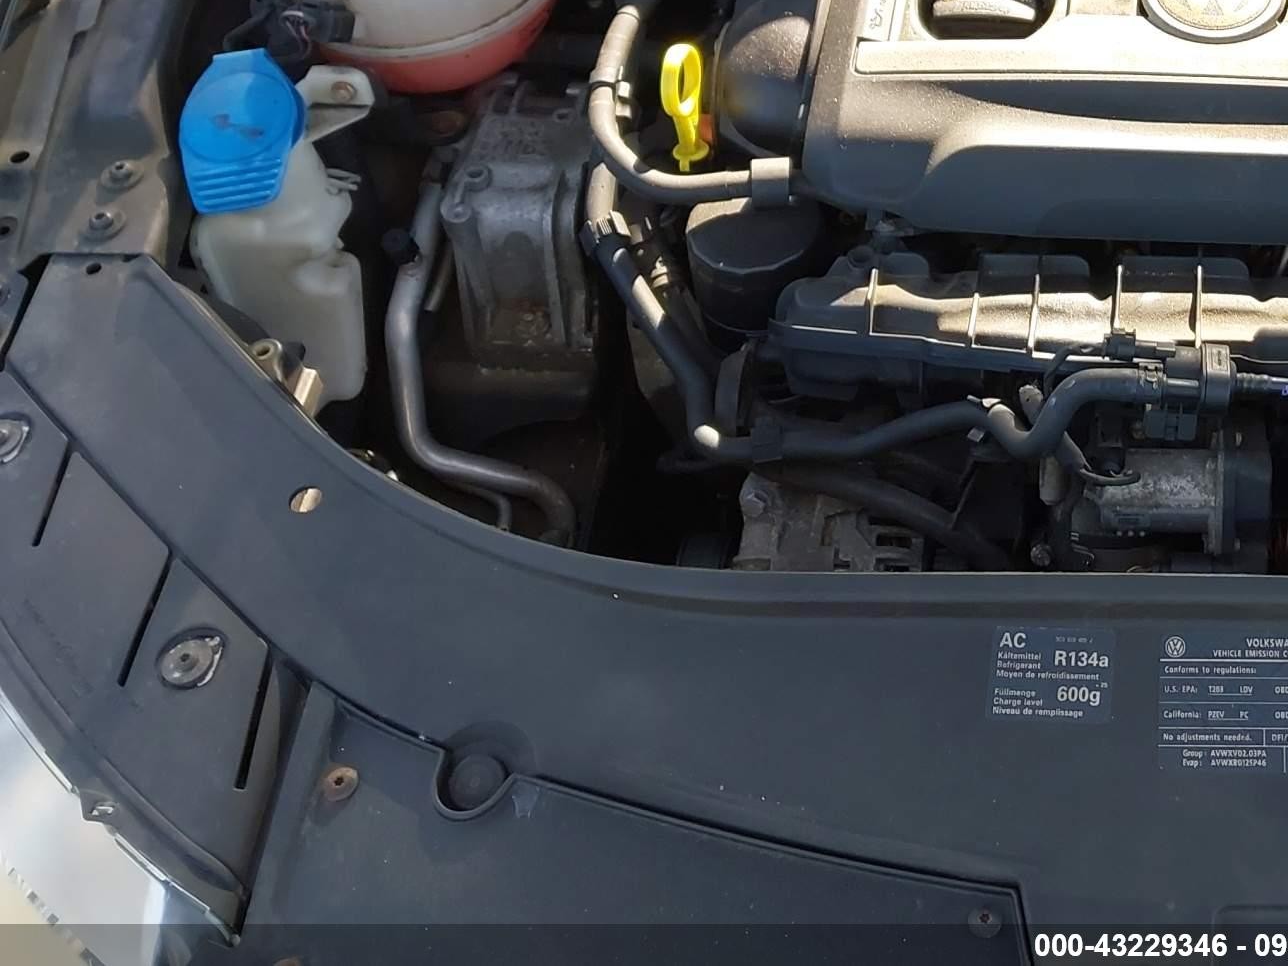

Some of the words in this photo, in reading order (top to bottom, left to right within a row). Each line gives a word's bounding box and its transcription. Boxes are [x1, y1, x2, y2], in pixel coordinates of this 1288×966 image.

[1000, 632, 1027, 648] AC
[1054, 650, 1109, 667] R134a
[1213, 649, 1242, 657] VEHICLE
[1245, 650, 1280, 658] EMISSION
[1164, 666, 1199, 674] Conforms
[1202, 666, 1210, 674] to
[1057, 686, 1101, 707] 600g
[993, 697, 1022, 707] Charge
[992, 706, 1020, 715] Niveau
[1163, 733, 1174, 741] No
[1176, 733, 1221, 743] adjustments
